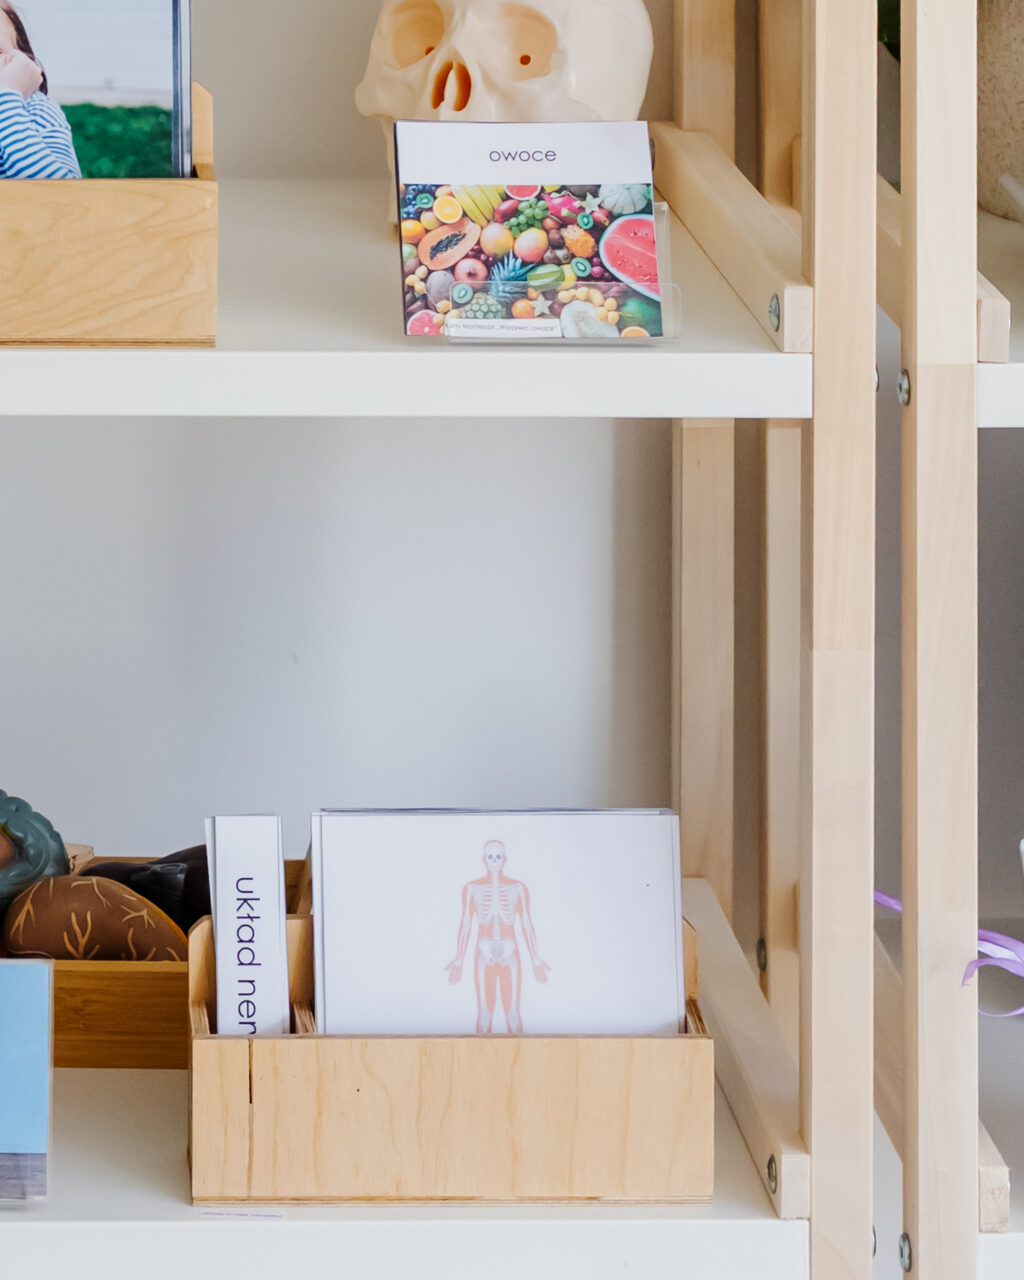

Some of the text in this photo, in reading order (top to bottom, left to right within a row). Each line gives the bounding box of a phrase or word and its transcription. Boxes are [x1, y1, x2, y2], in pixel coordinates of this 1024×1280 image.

[489, 150, 557, 162] owoce
[236, 877, 262, 1034] układ ner
